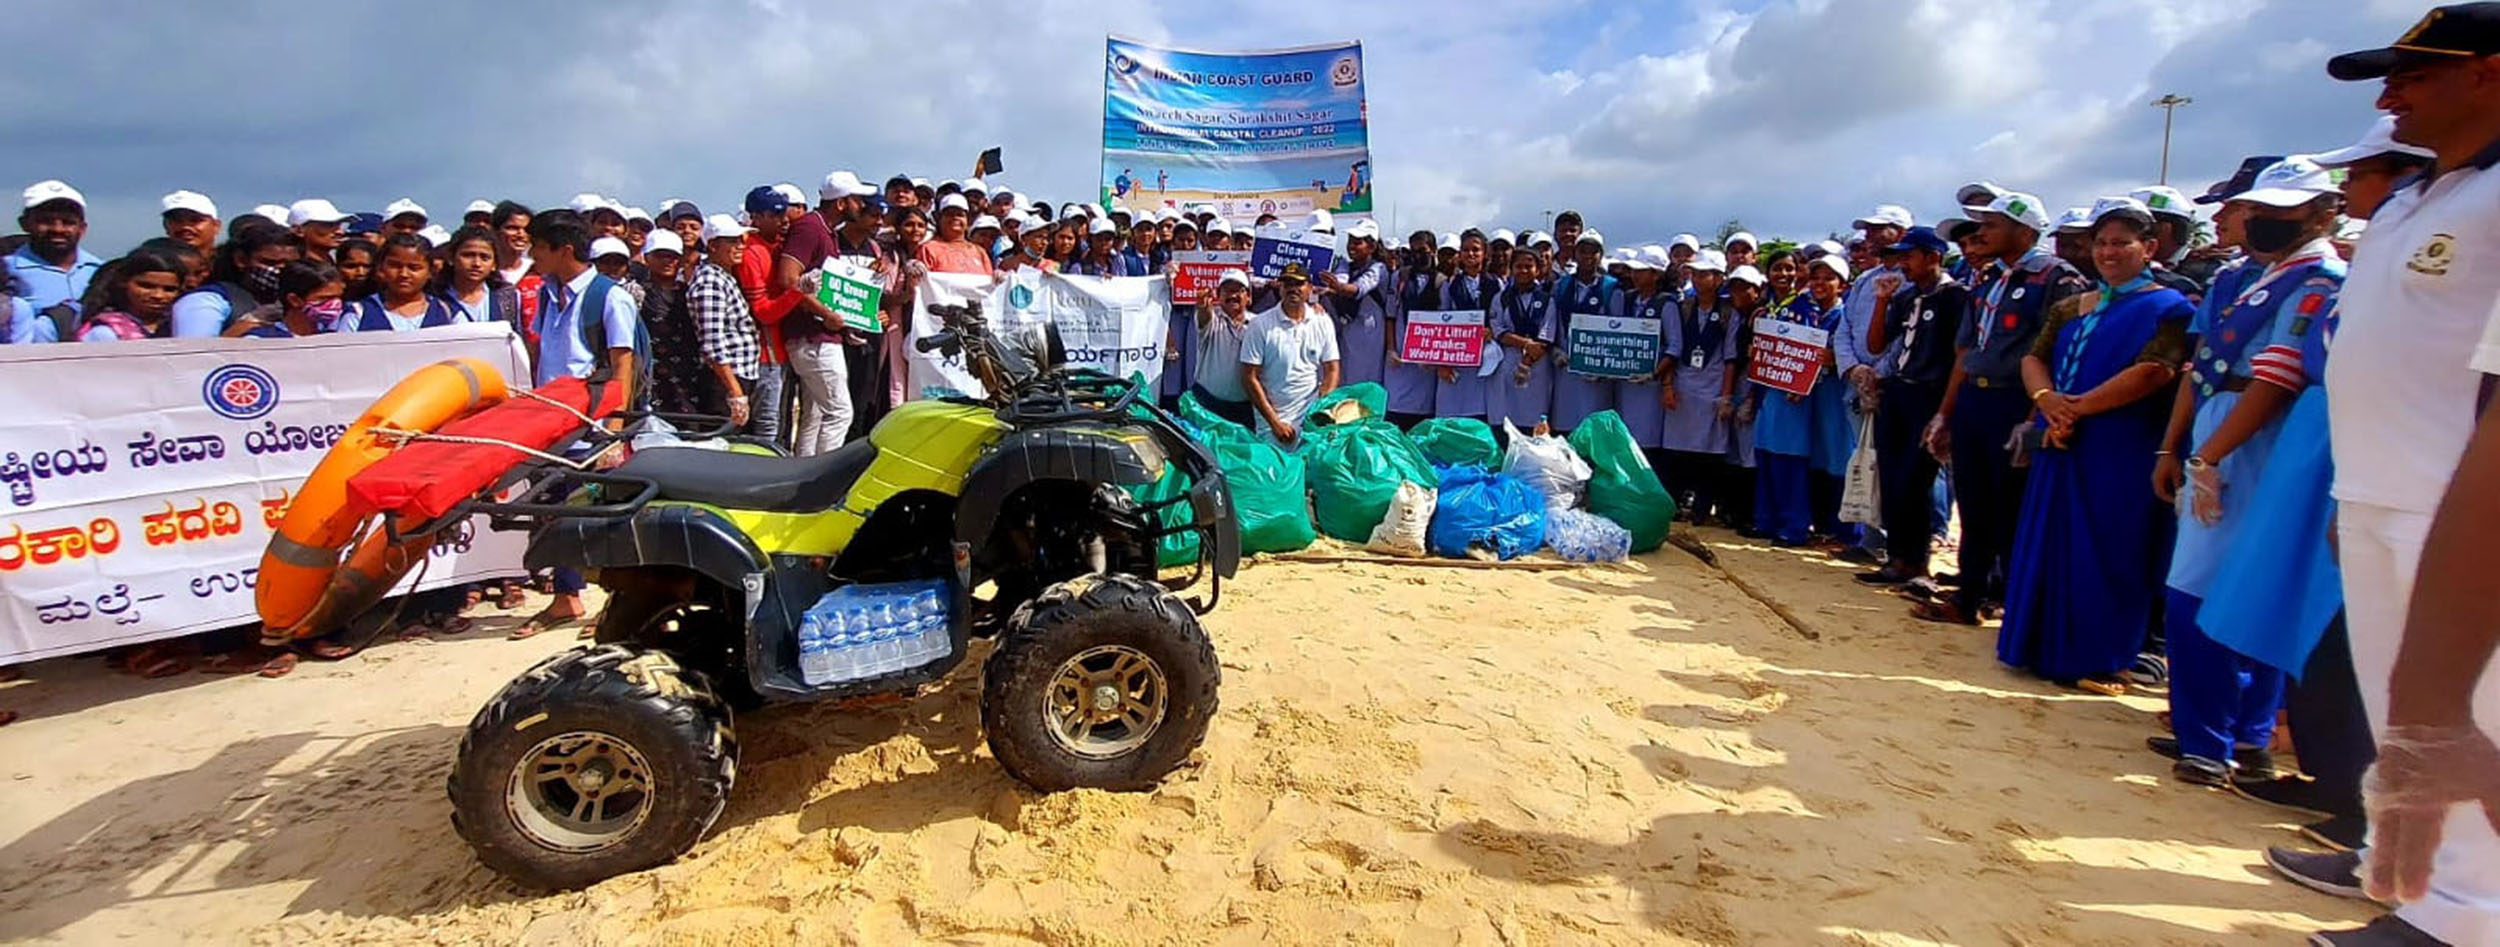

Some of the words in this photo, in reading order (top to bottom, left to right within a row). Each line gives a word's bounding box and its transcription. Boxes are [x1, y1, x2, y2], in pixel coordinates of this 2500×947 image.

[1207, 74, 1256, 87] COAST
[1261, 71, 1314, 86] GUARD
[1296, 109, 1333, 122] Sagar
[1277, 243, 1309, 257] Clean
[843, 281, 870, 300] Green
[1413, 325, 1442, 338] Don't
[1445, 326, 1477, 338] Litter!
[1432, 339, 1467, 350] makes
[1579, 332, 1593, 344] Do
[1596, 335, 1650, 350] something
[1409, 348, 1440, 360] World
[1443, 349, 1476, 362] better
[1623, 348, 1634, 358] to
[1636, 350, 1654, 359] cut
[1584, 356, 1601, 367] the
[1603, 357, 1640, 370] Plastic
[1754, 350, 1761, 362] A
[1762, 351, 1805, 373] Paradise
[1766, 367, 1793, 384] Earth
[128, 431, 226, 468] ಸೇವಾ
[244, 420, 348, 455] ಯೋಜ
[142, 497, 242, 546] ಪದವಿ
